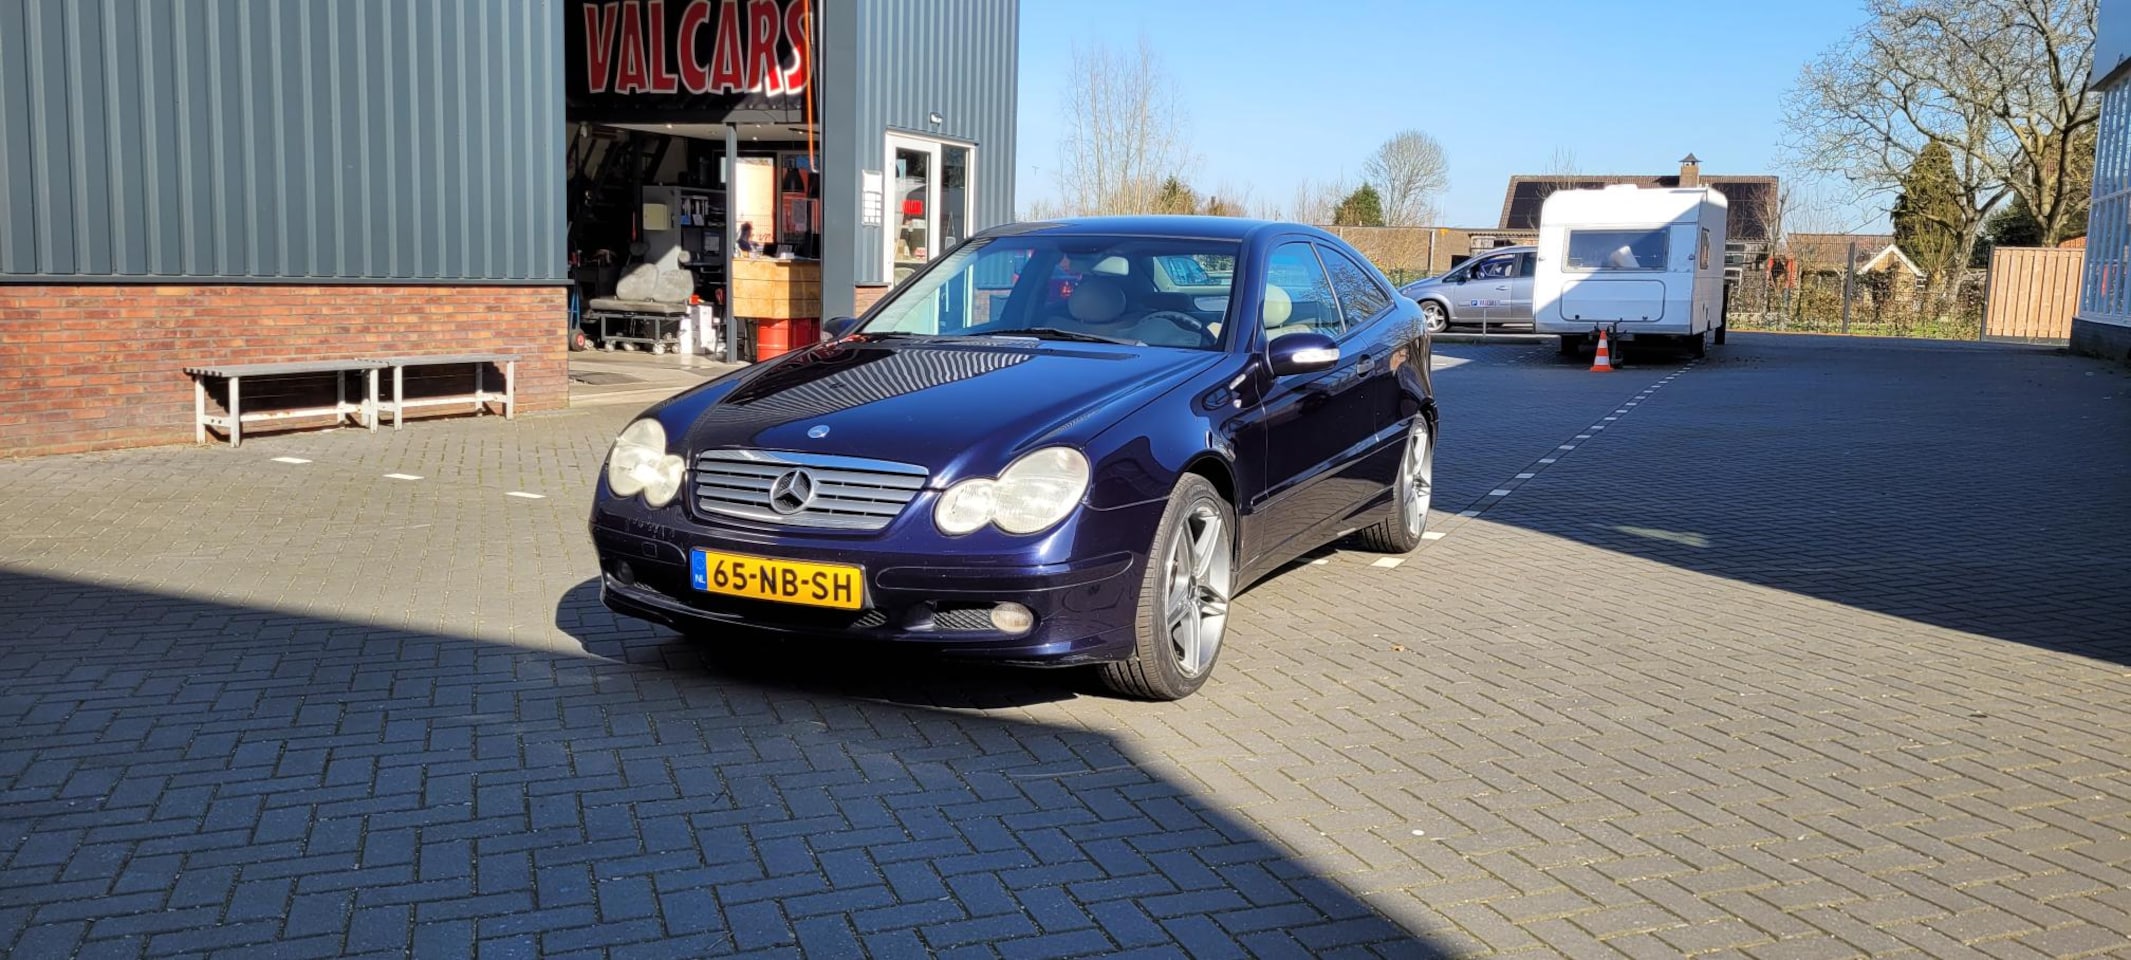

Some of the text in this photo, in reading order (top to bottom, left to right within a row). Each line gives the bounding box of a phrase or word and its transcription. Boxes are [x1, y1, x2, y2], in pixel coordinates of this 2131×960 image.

[583, 0, 815, 98] VALCARS
[694, 559, 852, 602] NL 65-NB-SH
